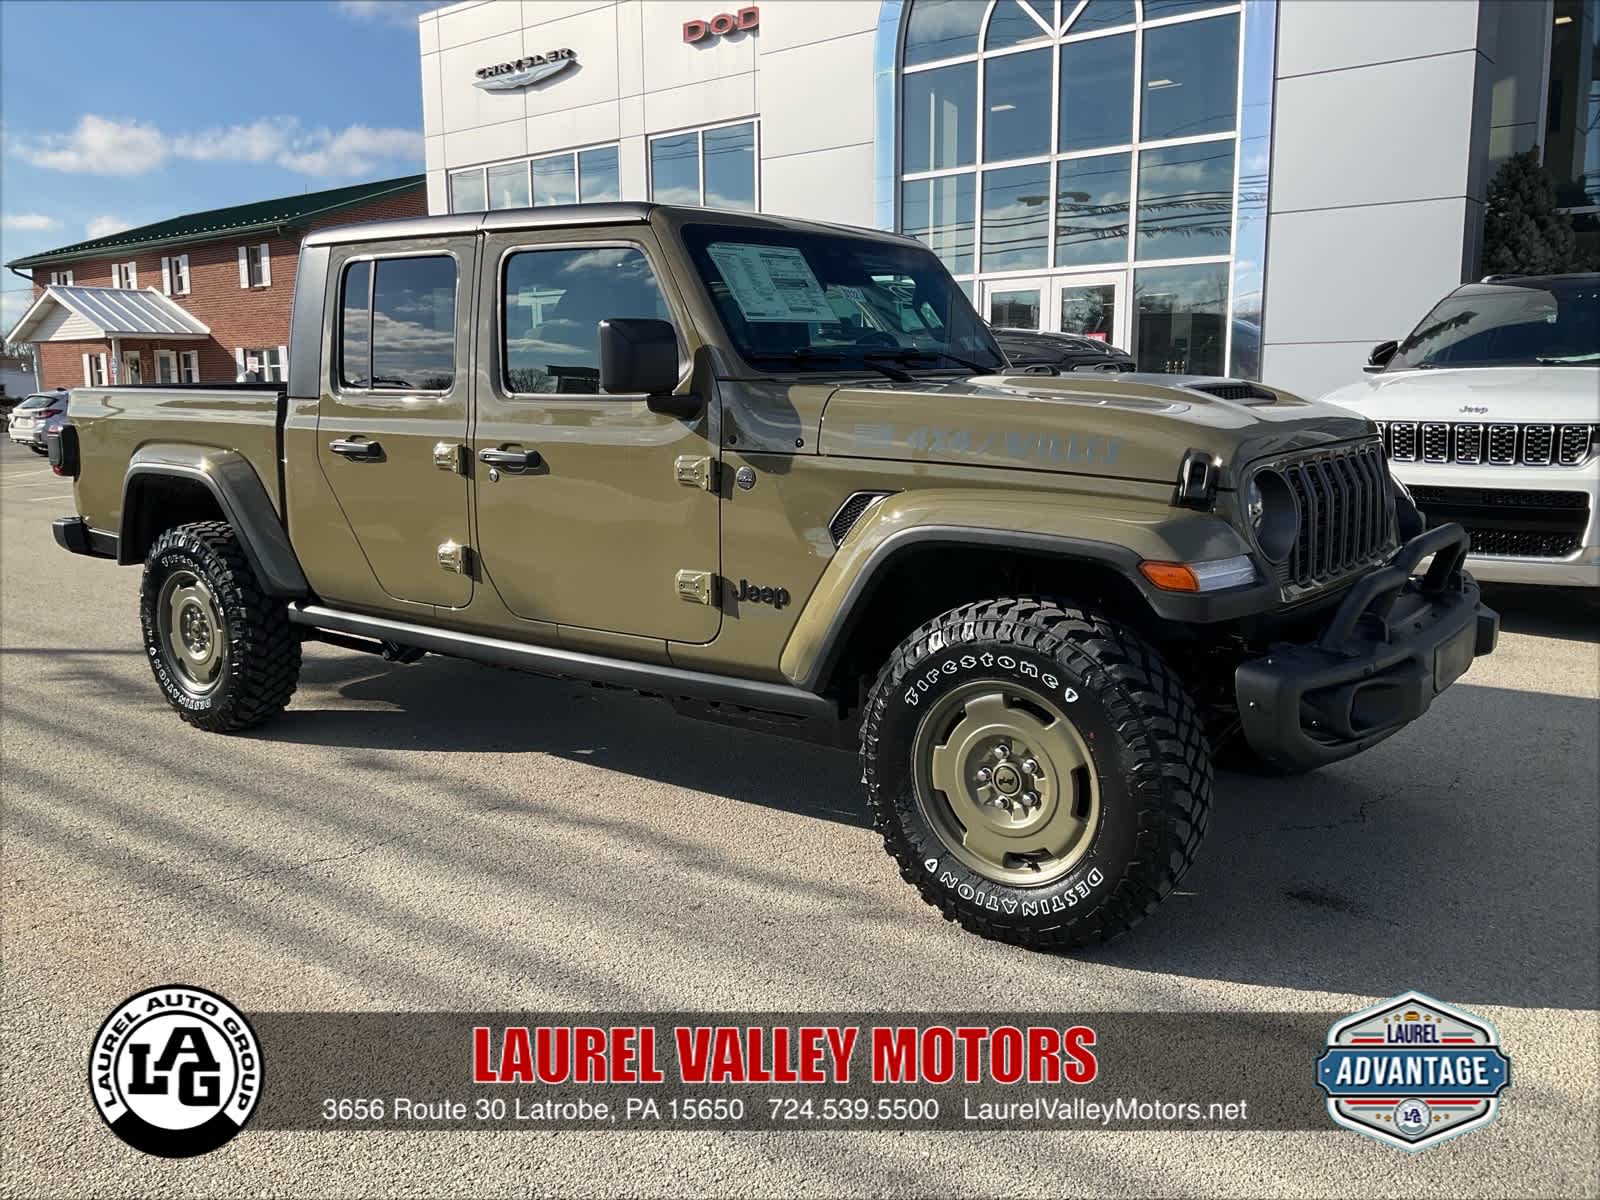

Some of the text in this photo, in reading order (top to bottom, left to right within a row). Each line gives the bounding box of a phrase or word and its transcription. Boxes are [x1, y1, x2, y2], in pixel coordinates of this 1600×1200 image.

[475, 47, 577, 80] CHRYSLER
[1459, 404, 1488, 415] Jeep
[733, 578, 791, 610] Jeep
[939, 866, 1104, 917] DESTINATION
